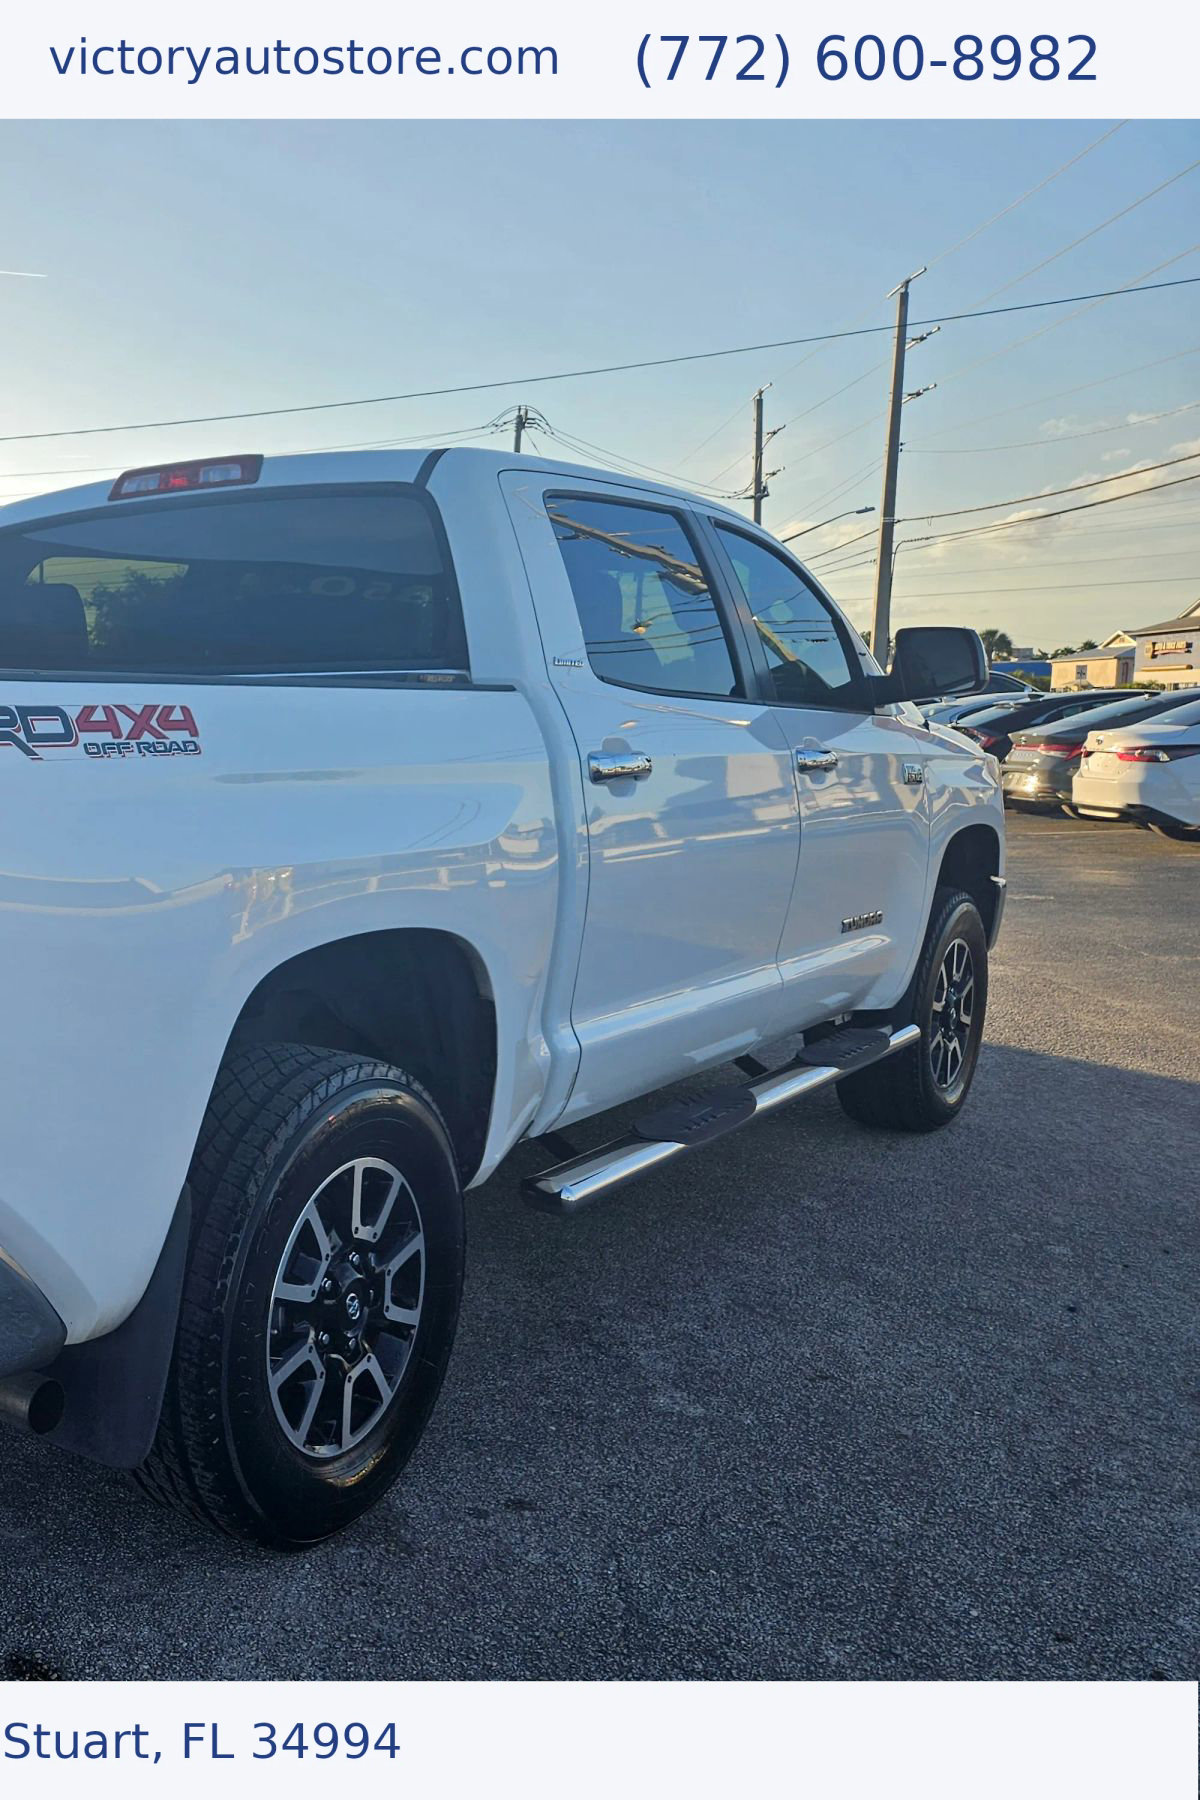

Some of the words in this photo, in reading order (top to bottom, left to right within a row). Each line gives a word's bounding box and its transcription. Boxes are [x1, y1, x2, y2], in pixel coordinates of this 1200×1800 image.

[75, 704, 200, 741] 4X4
[83, 741, 135, 758] OFF
[137, 740, 202, 757] ROAD
